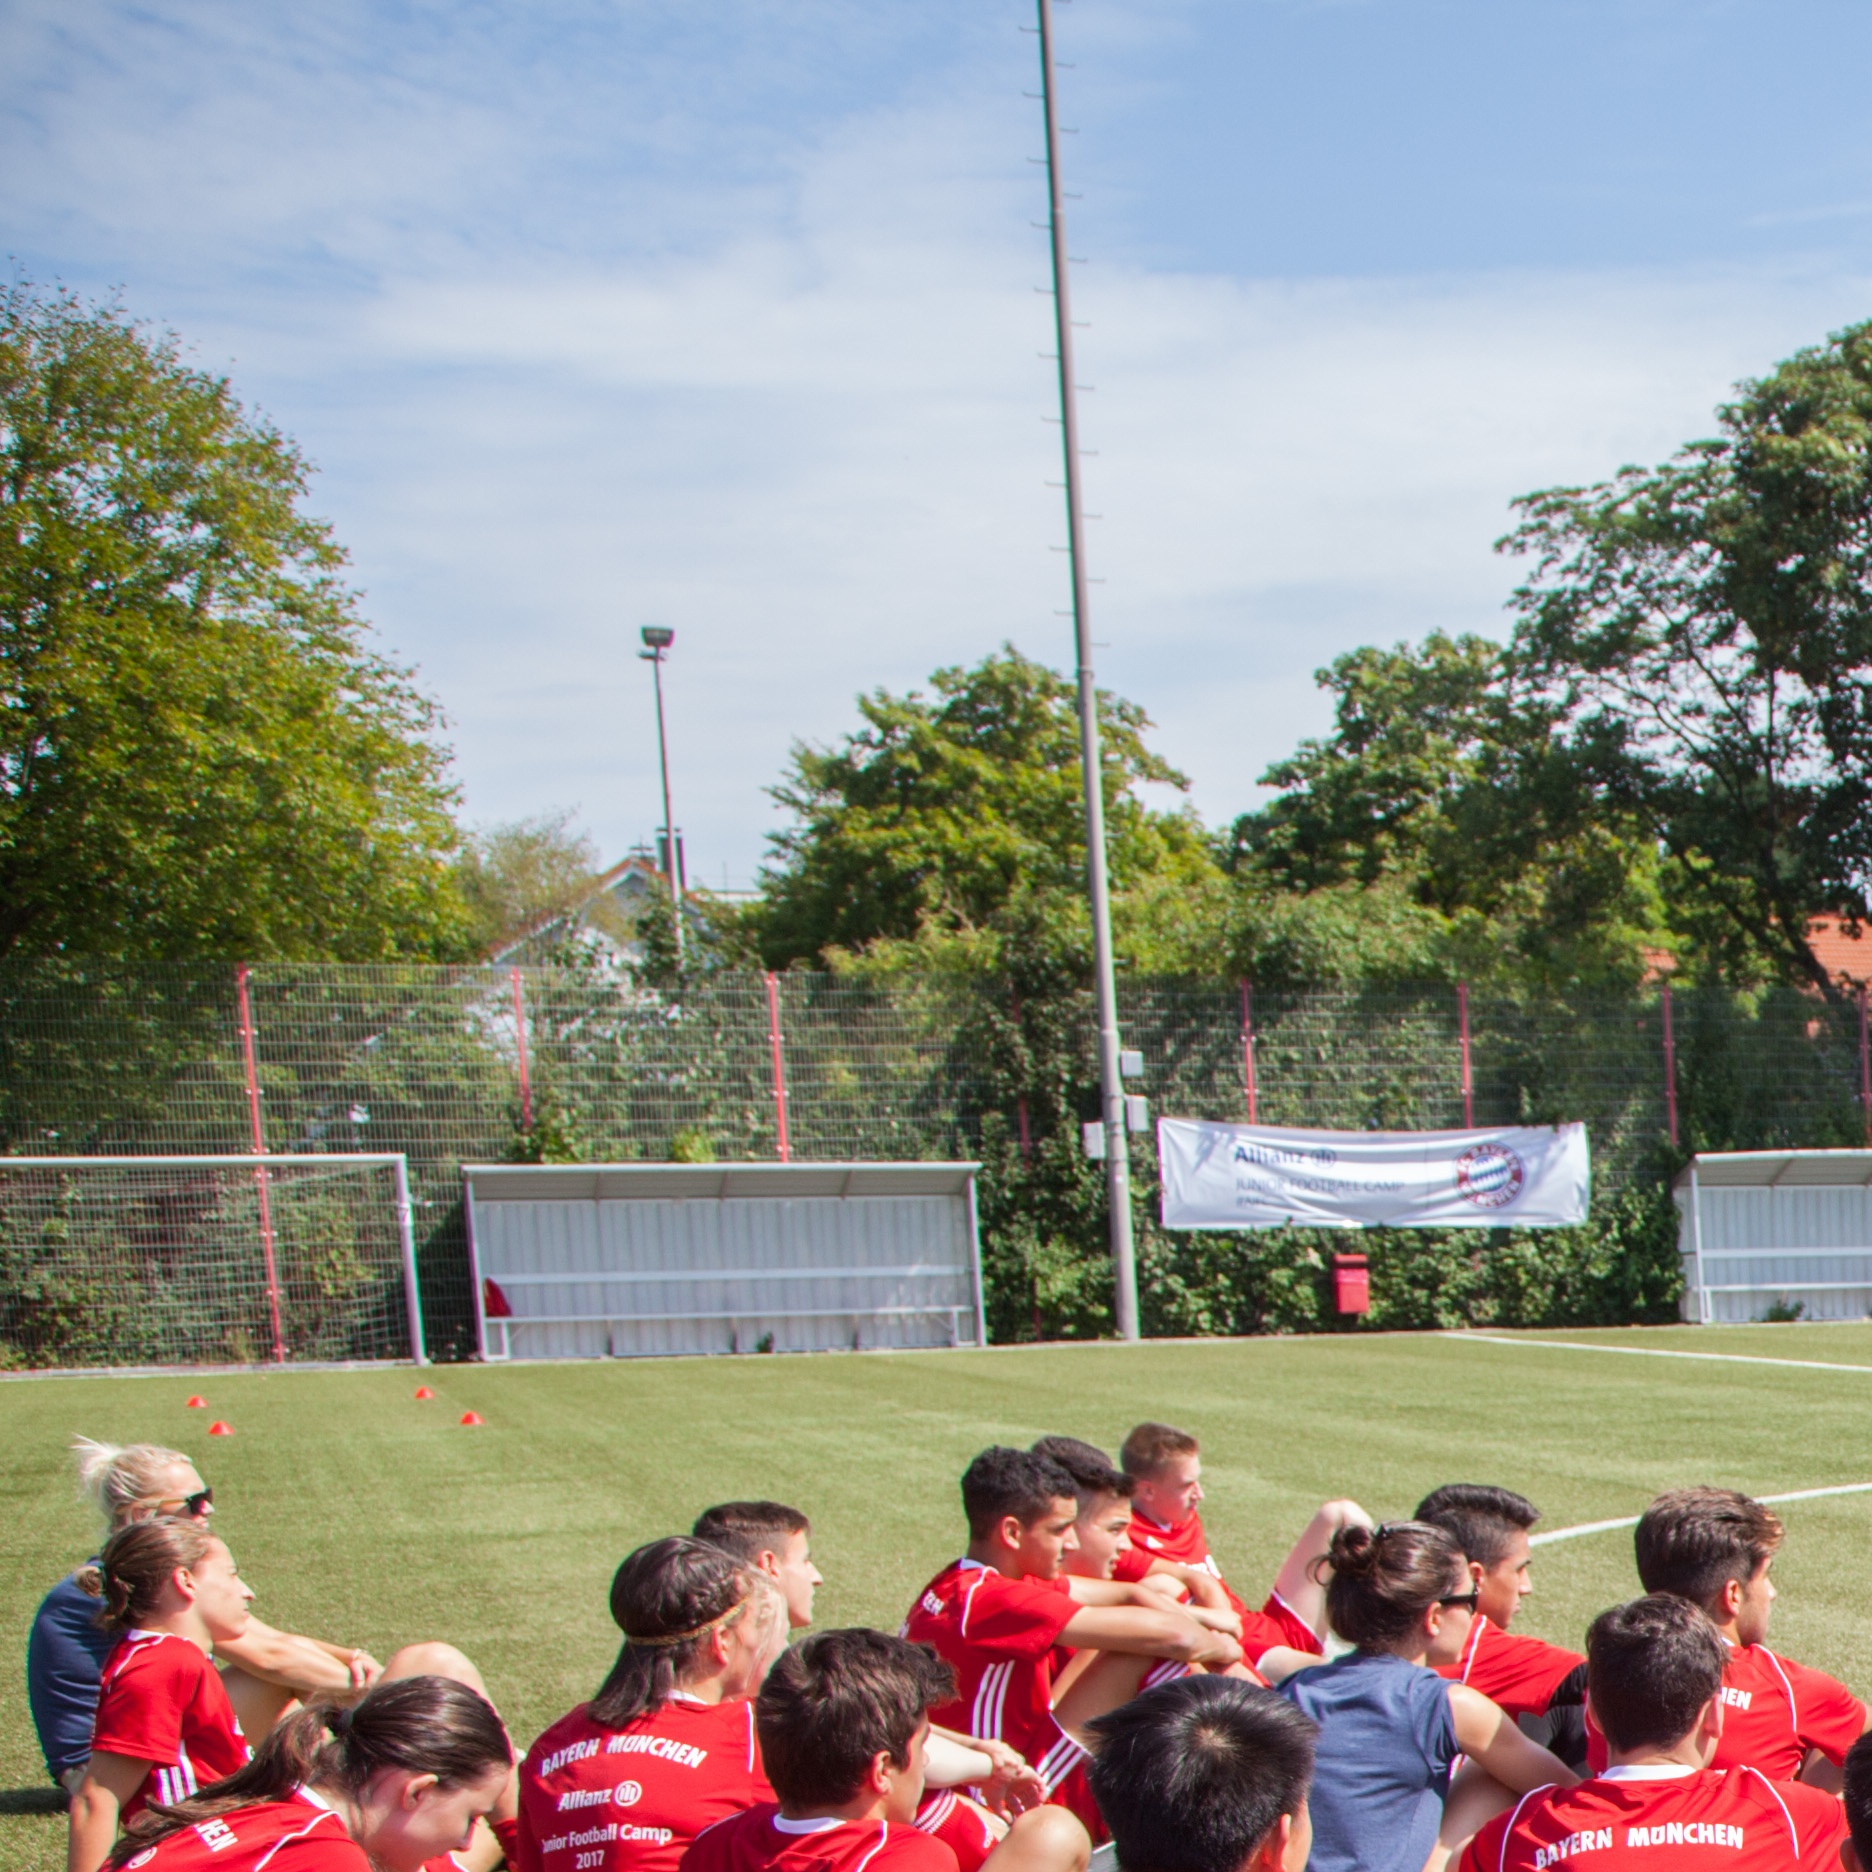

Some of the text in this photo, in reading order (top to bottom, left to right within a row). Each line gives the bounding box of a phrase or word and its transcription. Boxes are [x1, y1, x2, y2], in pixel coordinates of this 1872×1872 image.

[1289, 1177, 1362, 1192] FOOTBALL
[541, 1734, 708, 1778] BAYERN MÜNCHEN
[558, 1786, 612, 1811] Allianz
[568, 1822, 673, 1849] Football Camp
[1535, 1822, 1744, 1871] BAYERN MÜNCHEN
[575, 1850, 606, 1870] 2017
